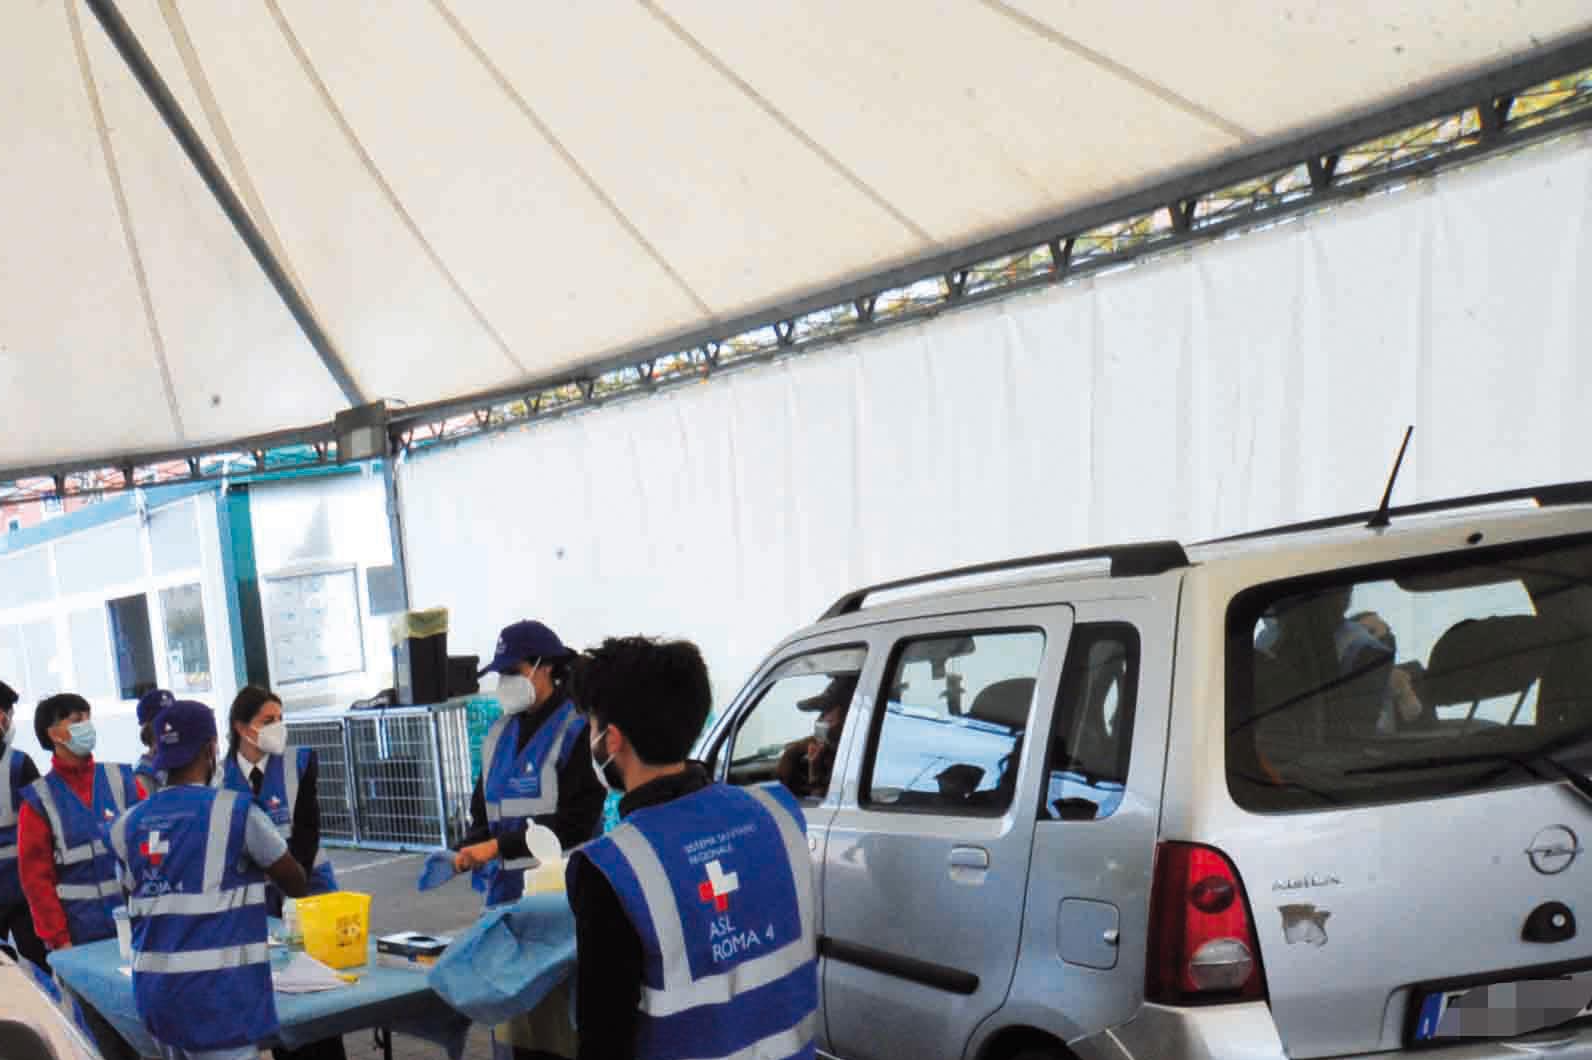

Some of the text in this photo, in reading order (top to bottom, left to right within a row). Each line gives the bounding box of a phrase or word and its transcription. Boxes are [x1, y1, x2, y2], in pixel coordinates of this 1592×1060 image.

[710, 914, 737, 941] ASL
[712, 923, 775, 963] ROMA 4
